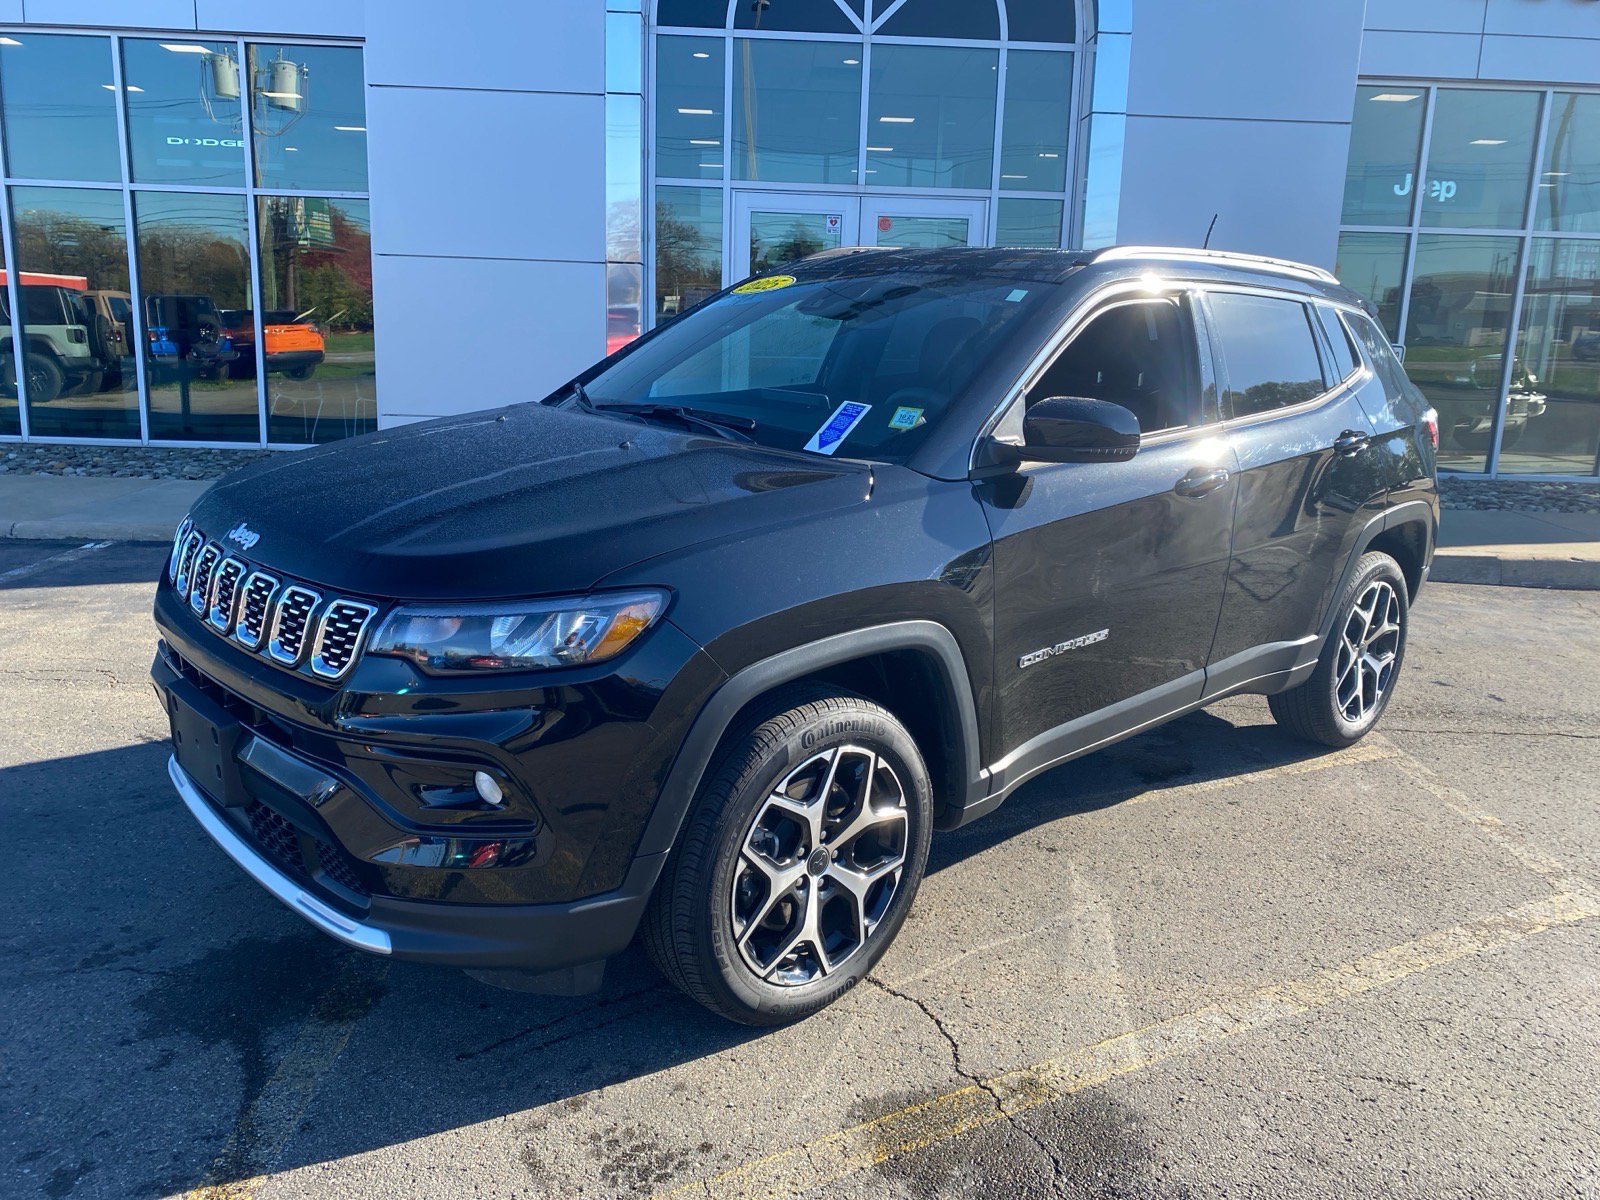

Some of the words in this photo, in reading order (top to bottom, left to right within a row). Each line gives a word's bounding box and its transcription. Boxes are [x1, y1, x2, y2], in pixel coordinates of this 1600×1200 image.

[1393, 173, 1457, 202] Jep
[229, 522, 261, 551] Jeep
[1019, 628, 1110, 669] COMPASS
[801, 718, 876, 750] Continental
